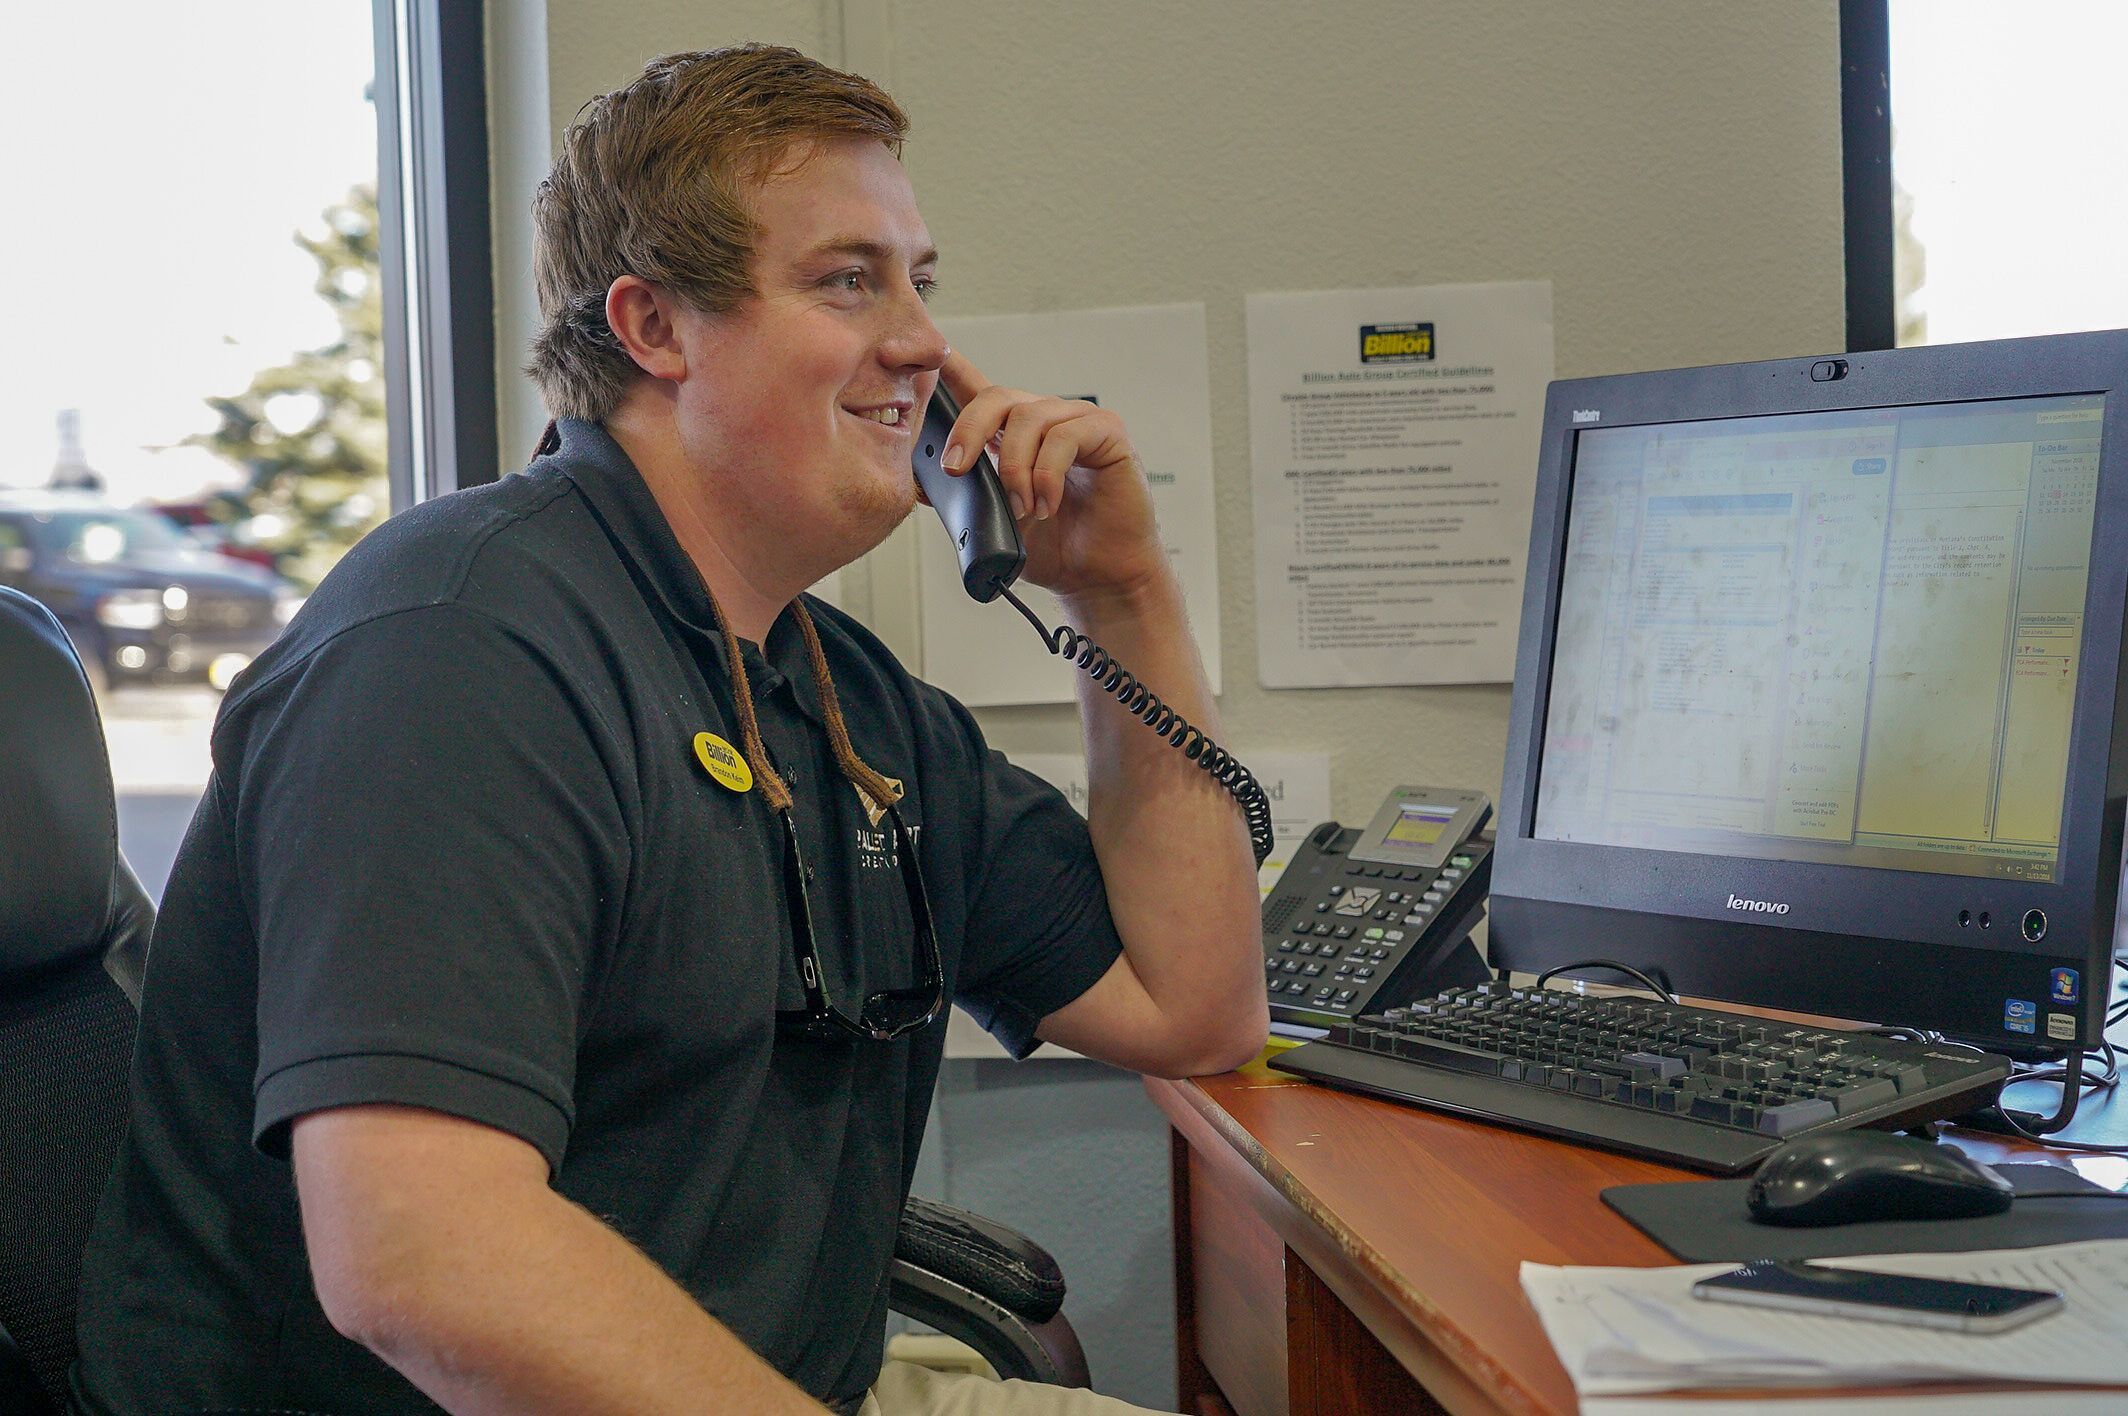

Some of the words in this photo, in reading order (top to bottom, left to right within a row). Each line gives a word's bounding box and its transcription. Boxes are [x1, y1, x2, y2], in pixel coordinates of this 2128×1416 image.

[1364, 332, 1430, 355] Billion
[704, 740, 738, 769] Billion
[1726, 893, 1790, 915] lenovo
